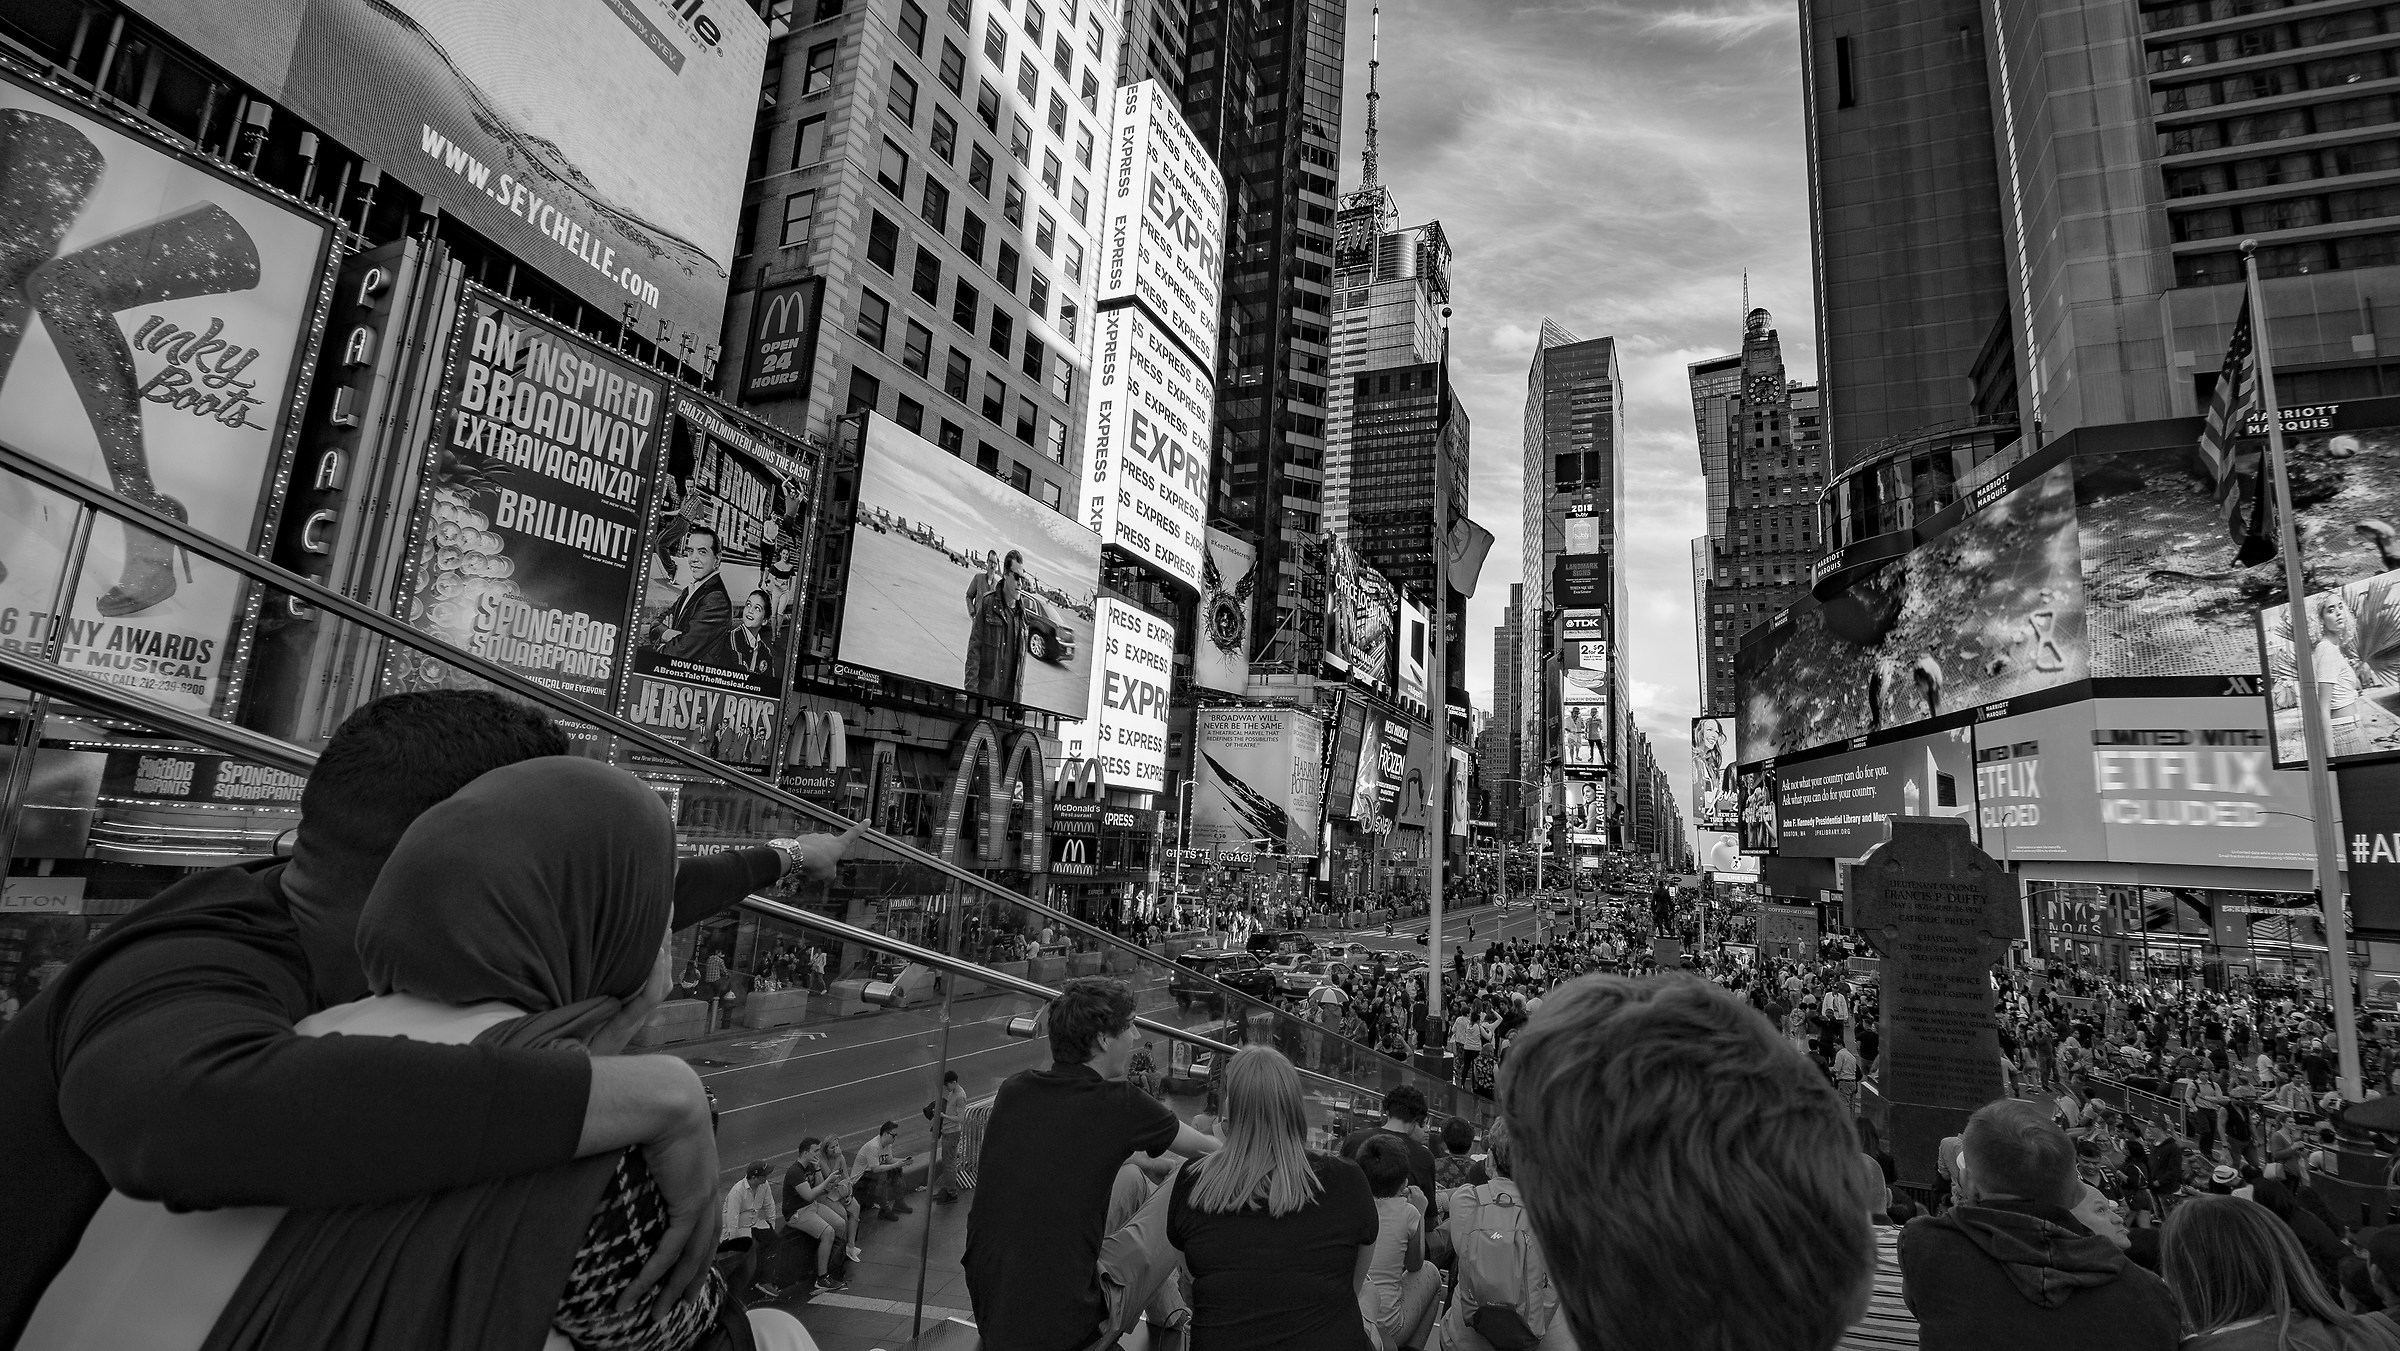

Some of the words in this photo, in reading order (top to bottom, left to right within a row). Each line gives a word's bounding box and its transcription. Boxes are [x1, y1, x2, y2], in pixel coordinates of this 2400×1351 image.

[1167, 109, 1207, 171] EXPRESS
[1117, 125, 1135, 198] EXPRESS
[1150, 113, 1180, 162] PRESS
[1184, 159, 1220, 217] EXPRESS
[1163, 161, 1203, 221] EXPRESS
[1110, 214, 1127, 290] EXPRESS
[1141, 214, 1172, 259] PRESS
[1177, 255, 1214, 307] EXPRESS
[1155, 261, 1196, 315] EXPRESS
[1136, 273, 1168, 315] PRESS
[1172, 310, 1210, 360] EXPRESS
[761, 337, 799, 354] OPEN
[1102, 309, 1120, 386] EXPRESS
[1149, 333, 1191, 383] EXPRESS
[762, 351, 792, 374] 24
[524, 338, 655, 427] INSPIRED
[751, 371, 799, 389] HOURS
[1130, 345, 1163, 385] PRESS
[1168, 379, 1206, 424] EXPRESS
[138, 365, 268, 431] Boots
[460, 360, 649, 471] BROADWAY
[1145, 390, 1188, 437] EXPRESS
[678, 399, 704, 425] CHAZZ
[704, 414, 752, 452] PALMINTERI
[752, 441, 775, 463] JOINS
[776, 454, 789, 473] THE
[789, 462, 811, 481] CAST!
[1094, 400, 1112, 483] EXPRESS
[718, 452, 768, 522] BRONX
[1122, 456, 1155, 491] PRESS
[1160, 483, 1199, 523] EXPRESS
[1977, 472, 2010, 498] MARRIOTT
[1977, 485, 2008, 507] MARQUIS
[1136, 499, 1180, 539] EXPRESS
[1571, 504, 1593, 513] 2018
[1116, 520, 1150, 552] PRESS
[1155, 543, 1196, 579] EXPRESS
[1817, 549, 1845, 570] MARRIOTT
[1565, 563, 1599, 571] LANDMARK
[1817, 561, 1841, 578] MARQUIS
[1335, 572, 1358, 600] OFFICE
[0, 607, 19, 635] 6
[106, 625, 214, 665] AWARDS
[476, 592, 617, 656] SPONGEBOB
[1573, 619, 1599, 627] TDK
[472, 633, 611, 680] SQUAREPANTS
[1125, 643, 1168, 674] EXPRESS
[1581, 645, 1588, 655] 2
[87, 651, 207, 681] MUSICAL
[653, 665, 762, 692] ABronxTaleTheMusical.com
[670, 659, 692, 672] NOW
[692, 662, 704, 673] ON
[705, 664, 750, 681] BROADWAY
[562, 682, 575, 691] FOR
[575, 684, 607, 696] EVERYONE
[630, 680, 720, 731] JERSEY
[721, 694, 775, 741] BOYS
[1986, 701, 2009, 712] MARRIOTT
[1986, 709, 2007, 718] MARQUIS
[1203, 722, 1229, 730] NEVER
[1231, 722, 1240, 730] BE
[1243, 722, 1259, 730] THE
[1260, 722, 1285, 730] SAME.
[1118, 728, 1162, 753] EXPRESS
[137, 755, 196, 781] SPONGEBOB
[1293, 755, 1319, 778] HARRY
[1378, 743, 1406, 778] FROZEN
[781, 775, 835, 788] McDonald's
[1291, 774, 1318, 796] POTTER
[1782, 779, 1791, 791] Ask
[1791, 780, 1799, 790] not
[1800, 776, 1811, 789] what
[1811, 778, 1823, 789] your
[1823, 773, 1844, 785] country
[1844, 771, 1855, 781] can
[1855, 766, 1864, 780] do
[1864, 764, 1874, 778] for
[1874, 766, 1889, 779] you.
[1053, 803, 1101, 813] McDonald's
[1595, 784, 1605, 833] FLAGSHIP
[1782, 793, 1791, 806] Ask
[1791, 792, 1802, 805] what
[1802, 795, 1812, 806] you
[1812, 793, 1822, 803] can
[1822, 788, 1829, 802] do
[1830, 787, 1838, 801] for
[1838, 790, 1851, 802] your
[1851, 786, 1877, 798] country.
[1783, 819, 1792, 828] John
[1792, 818, 1797, 827] F.
[1797, 816, 1815, 828] Kennedy
[1815, 814, 1843, 826] Presidential
[1843, 814, 1861, 825] Library
[1862, 813, 1872, 822] and
[1166, 849, 1197, 859] GIFTS
[1884, 890, 1932, 901] FRANCIS
[1947, 893, 1988, 905] DUFFY
[1890, 880, 1937, 890] LIEUTENANT
[1939, 883, 1980, 893] COLONEL
[1898, 914, 1940, 924] CATHOLIC
[1945, 917, 1975, 926] PRIEST
[2047, 901, 2100, 923] NYC
[1917, 934, 1958, 943] CHAPLAIN
[1911, 972, 1928, 981] LIFE
[1946, 976, 1981, 985] SERVICE
[1943, 991, 1984, 1000] COUNTRY
[1930, 1008, 1968, 1018] AMERICAN
